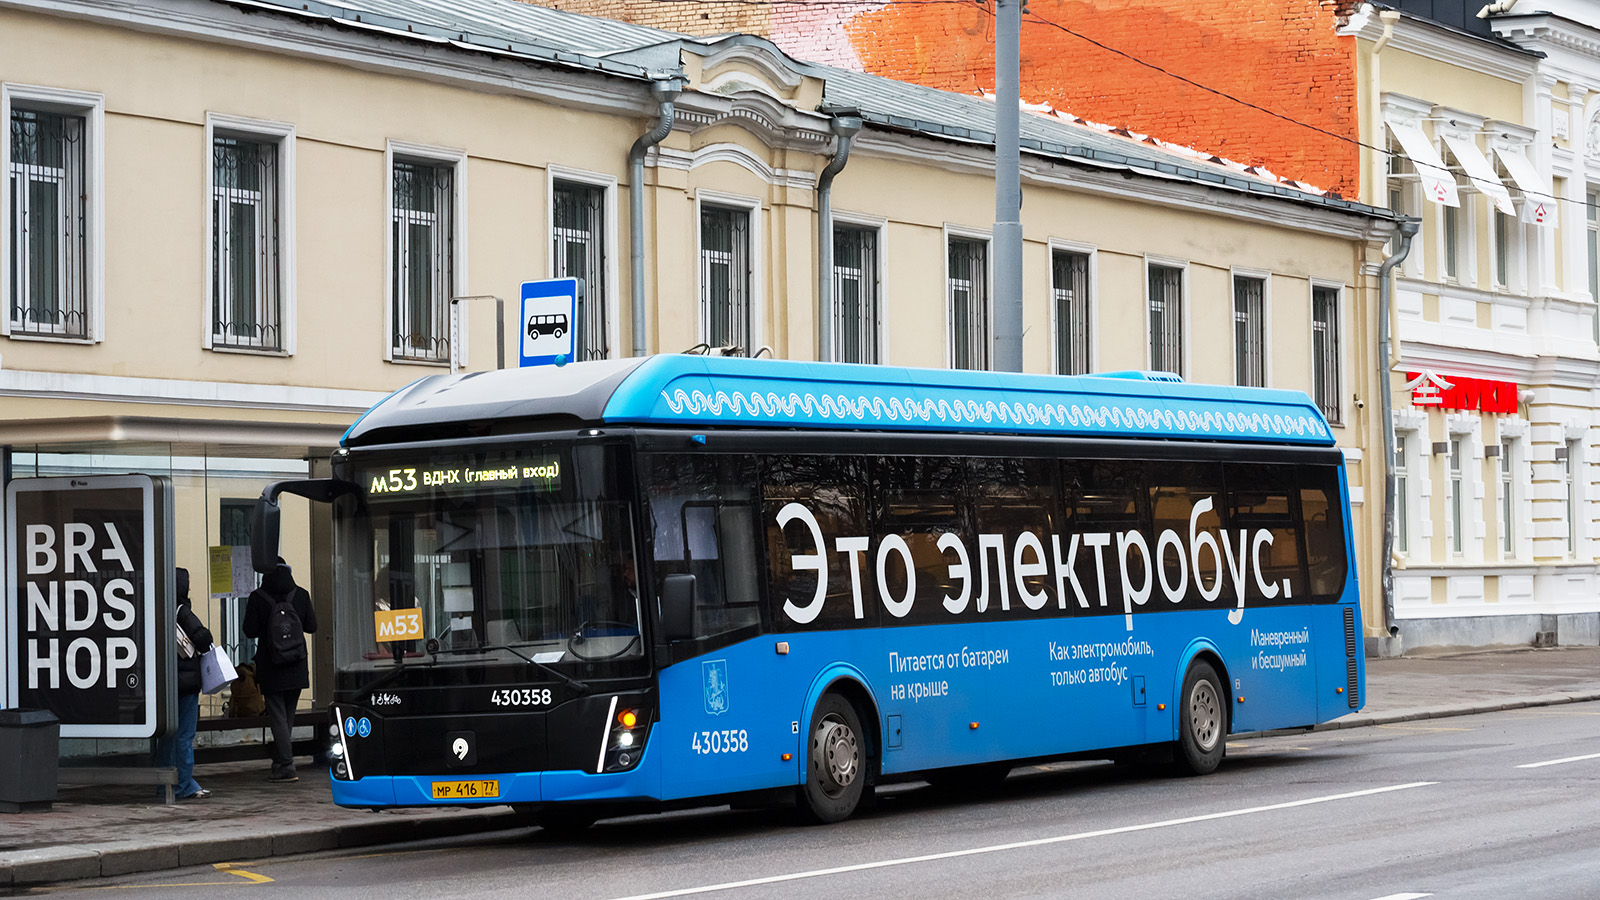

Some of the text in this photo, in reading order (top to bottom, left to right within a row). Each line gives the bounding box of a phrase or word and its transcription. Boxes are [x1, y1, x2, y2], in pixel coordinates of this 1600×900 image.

[422, 469, 461, 487] ВДНХ
[464, 465, 518, 484] (главный
[522, 461, 560, 480] вход)
[26, 522, 135, 575] BRA
[775, 496, 1292, 631] Это электробус.
[26, 578, 136, 632] NDS
[1049, 636, 1155, 661] Как электромобиль,
[1250, 626, 1309, 650] Маневренный
[28, 637, 138, 689] HOP
[889, 647, 1009, 674] Питается от батареи
[1251, 649, 1307, 674] и бесшумный
[1050, 664, 1128, 686] только автобус
[491, 688, 552, 706] 430358
[890, 680, 949, 703] на крыше
[692, 729, 749, 755] 430358
[456, 783, 477, 796] 416
[483, 781, 494, 792] 77
